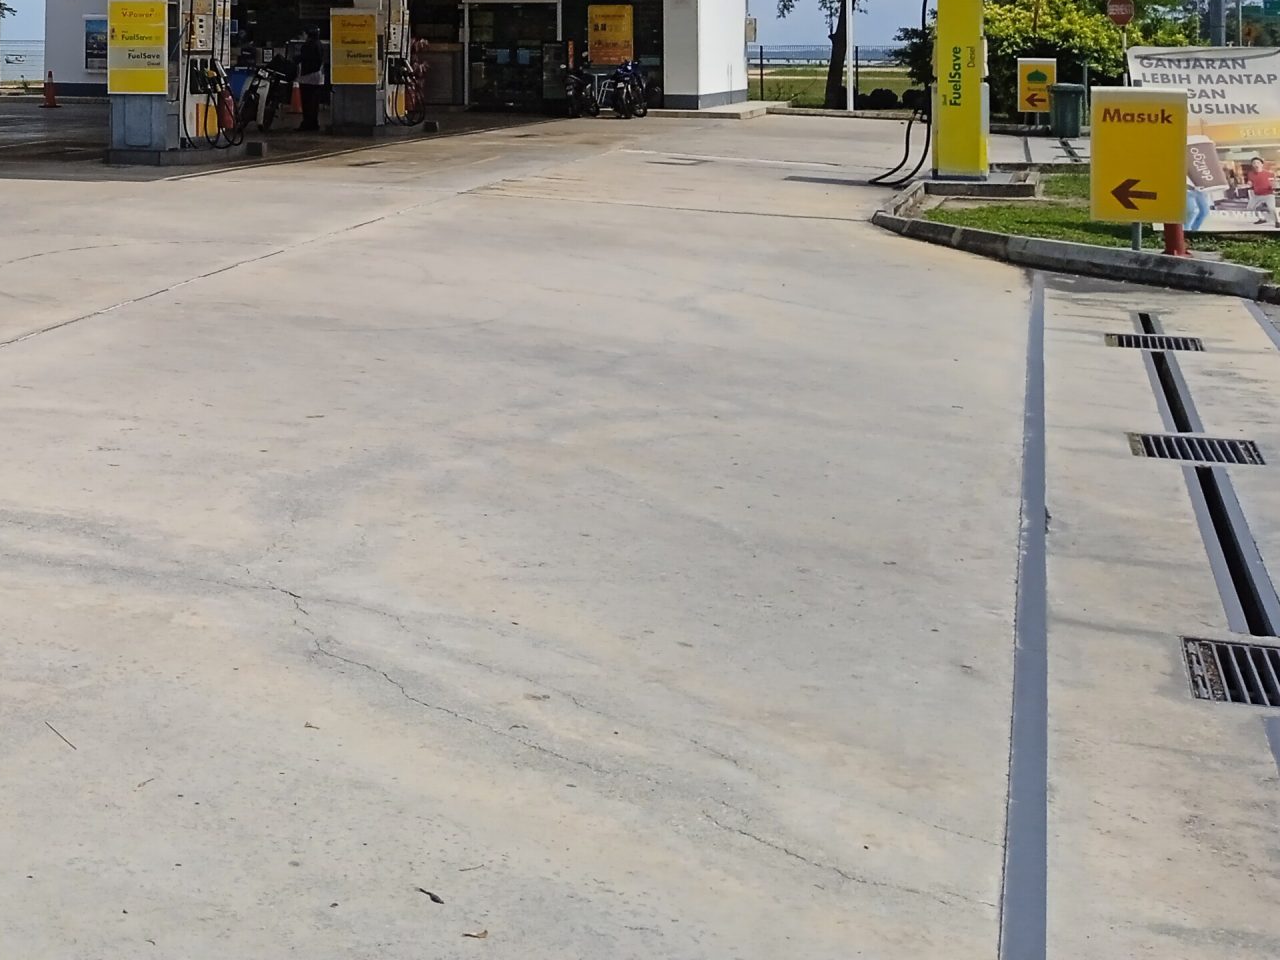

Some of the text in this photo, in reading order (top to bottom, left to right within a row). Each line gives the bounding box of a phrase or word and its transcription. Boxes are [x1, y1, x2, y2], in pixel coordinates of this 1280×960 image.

[121, 33, 153, 41] FuelSave
[127, 52, 161, 60] FuelSave
[1139, 58, 1247, 70] GANJARAN
[947, 46, 962, 107] FuelSave
[1141, 72, 1278, 85] LEBIH MANTAP
[1102, 107, 1173, 124] Masuk
[1190, 147, 1214, 181] deli2go
